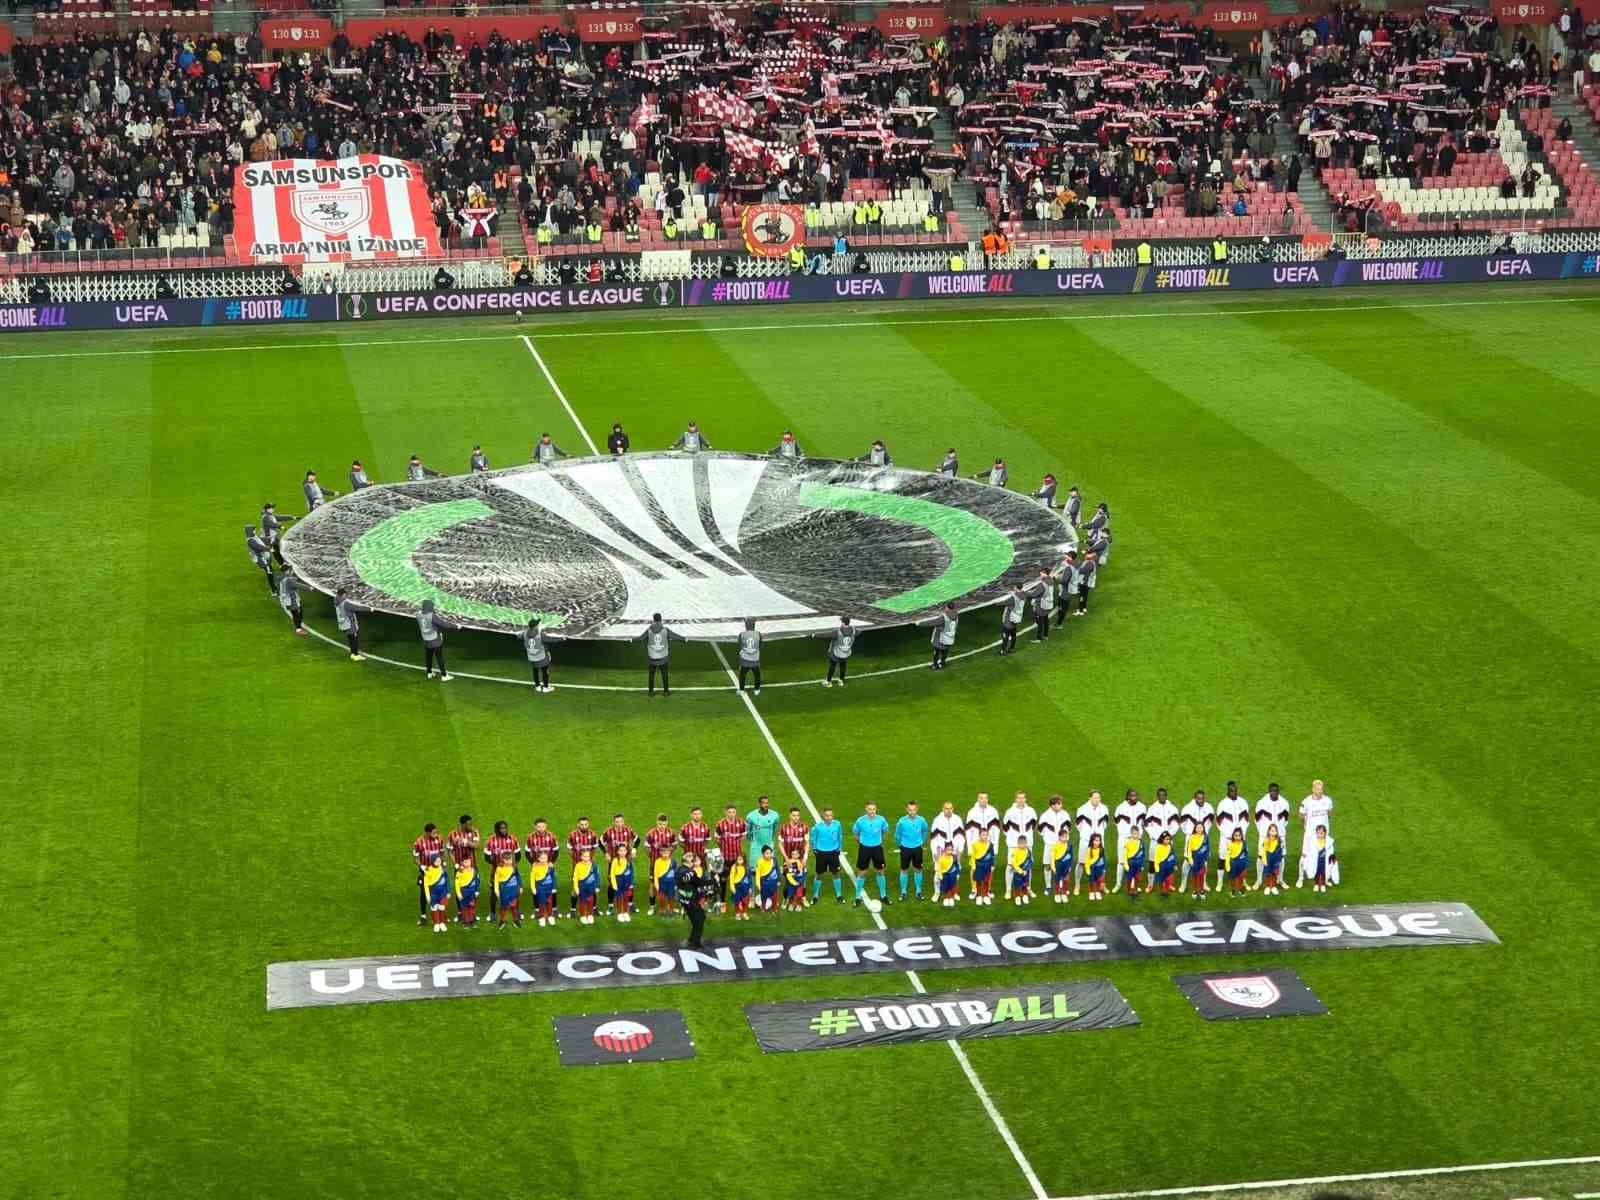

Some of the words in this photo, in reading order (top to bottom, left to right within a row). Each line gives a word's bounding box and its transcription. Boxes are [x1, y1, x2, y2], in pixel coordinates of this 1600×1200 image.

[1214, 12, 1229, 22] 133
[1243, 12, 1257, 22] 134
[1531, 5, 1545, 16] 135
[272, 29, 289, 39] 130
[304, 29, 320, 39] 131
[588, 23, 603, 33] 131
[619, 23, 634, 33] 132
[243, 163, 411, 187] SAMSUNSPOR
[1273, 266, 1319, 283] UEFA
[1362, 262, 1418, 281] WELCOME
[1419, 260, 1444, 279] ALL
[1486, 259, 1532, 276] UEFA
[836, 279, 884, 296] UEFA
[928, 274, 987, 294] WELCOME
[987, 273, 1013, 293] ALL
[1057, 273, 1104, 290] UEFA
[1155, 268, 1230, 288] #FOOTBALL
[376, 297, 428, 313] UEFA
[434, 289, 562, 311] CONFERENCE
[568, 286, 643, 305] LEAGUE
[712, 280, 791, 302] #FOOTBALL
[39, 305, 66, 327] ALL
[116, 305, 168, 323] UEFA
[225, 297, 309, 320] #FOOTBALL
[310, 957, 536, 995] UEFA
[557, 926, 1108, 980] CONFERENCE
[1128, 911, 1448, 947] LEAGUE
[810, 993, 1080, 1036] #FOOTBALL
